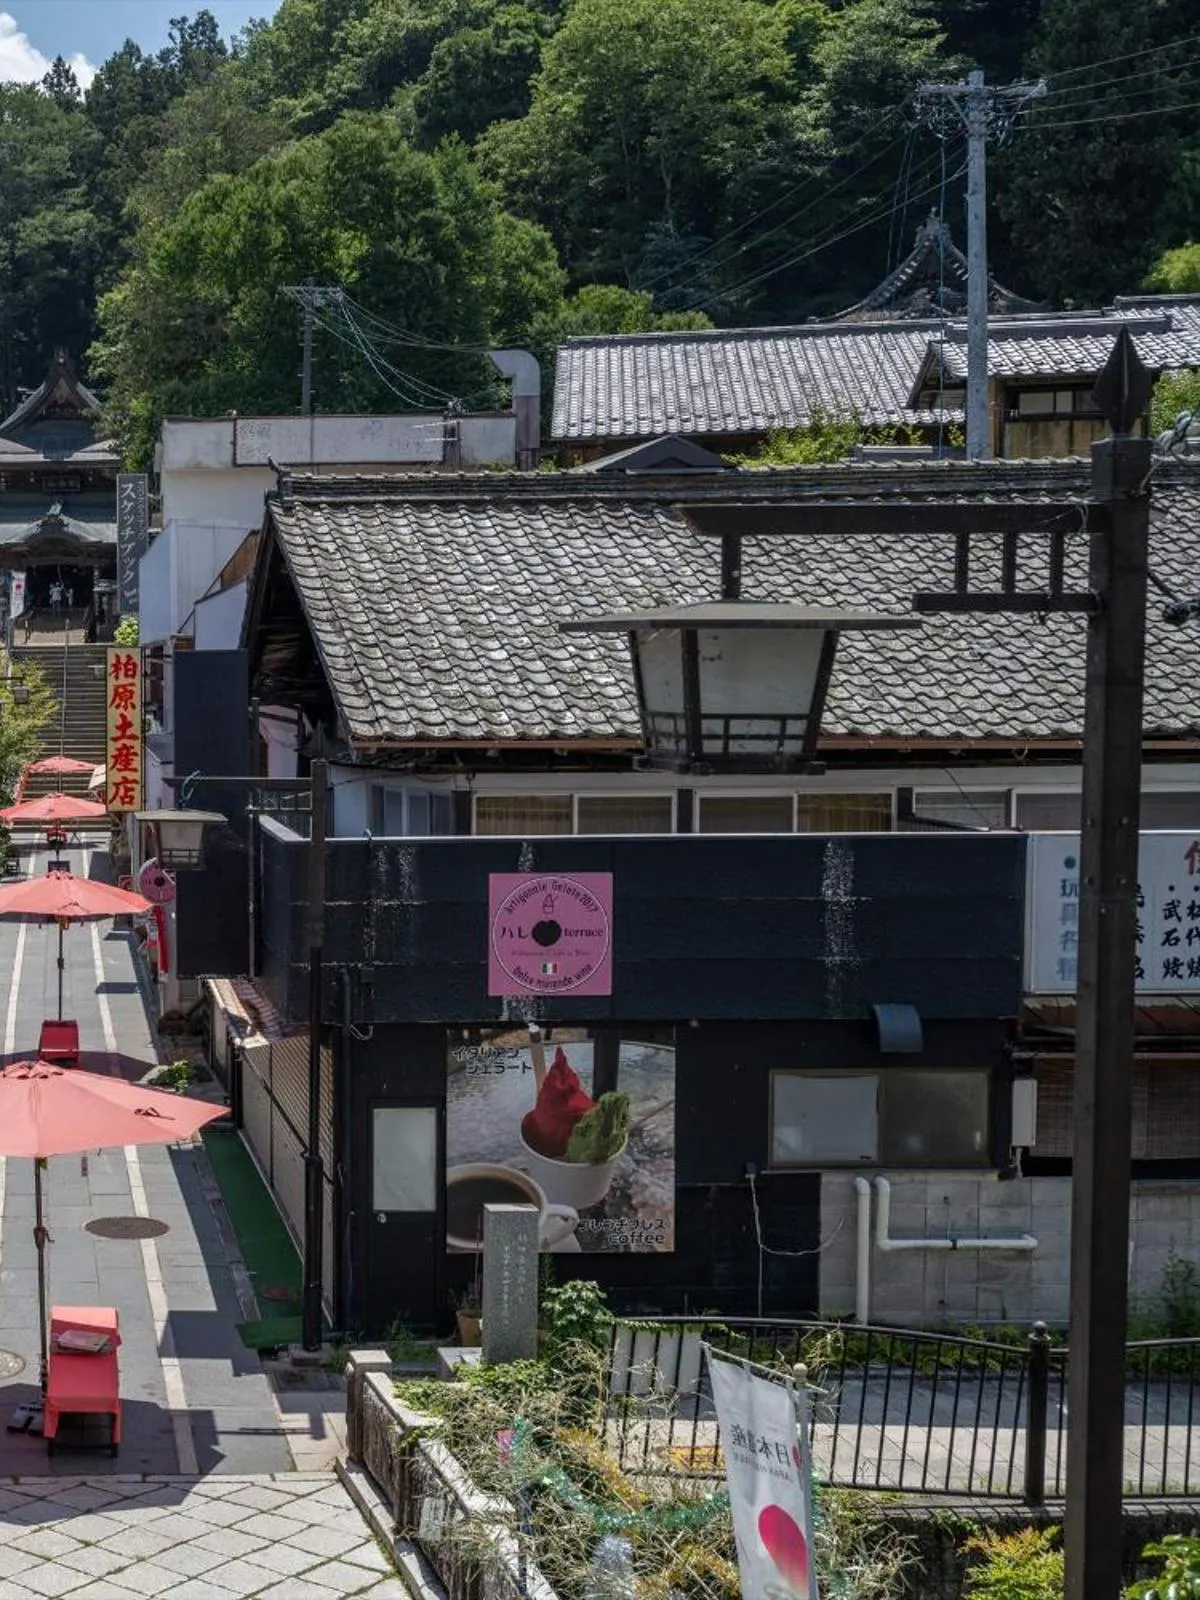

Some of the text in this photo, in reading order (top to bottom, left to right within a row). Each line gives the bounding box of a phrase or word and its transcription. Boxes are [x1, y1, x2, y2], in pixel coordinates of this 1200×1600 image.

[120, 483, 137, 584] スケッチブック
[109, 653, 139, 807] 柏原土産店
[452, 1045, 519, 1061] イタリアン
[465, 1060, 533, 1075] ジェラート
[608, 1231, 666, 1244] coffee
